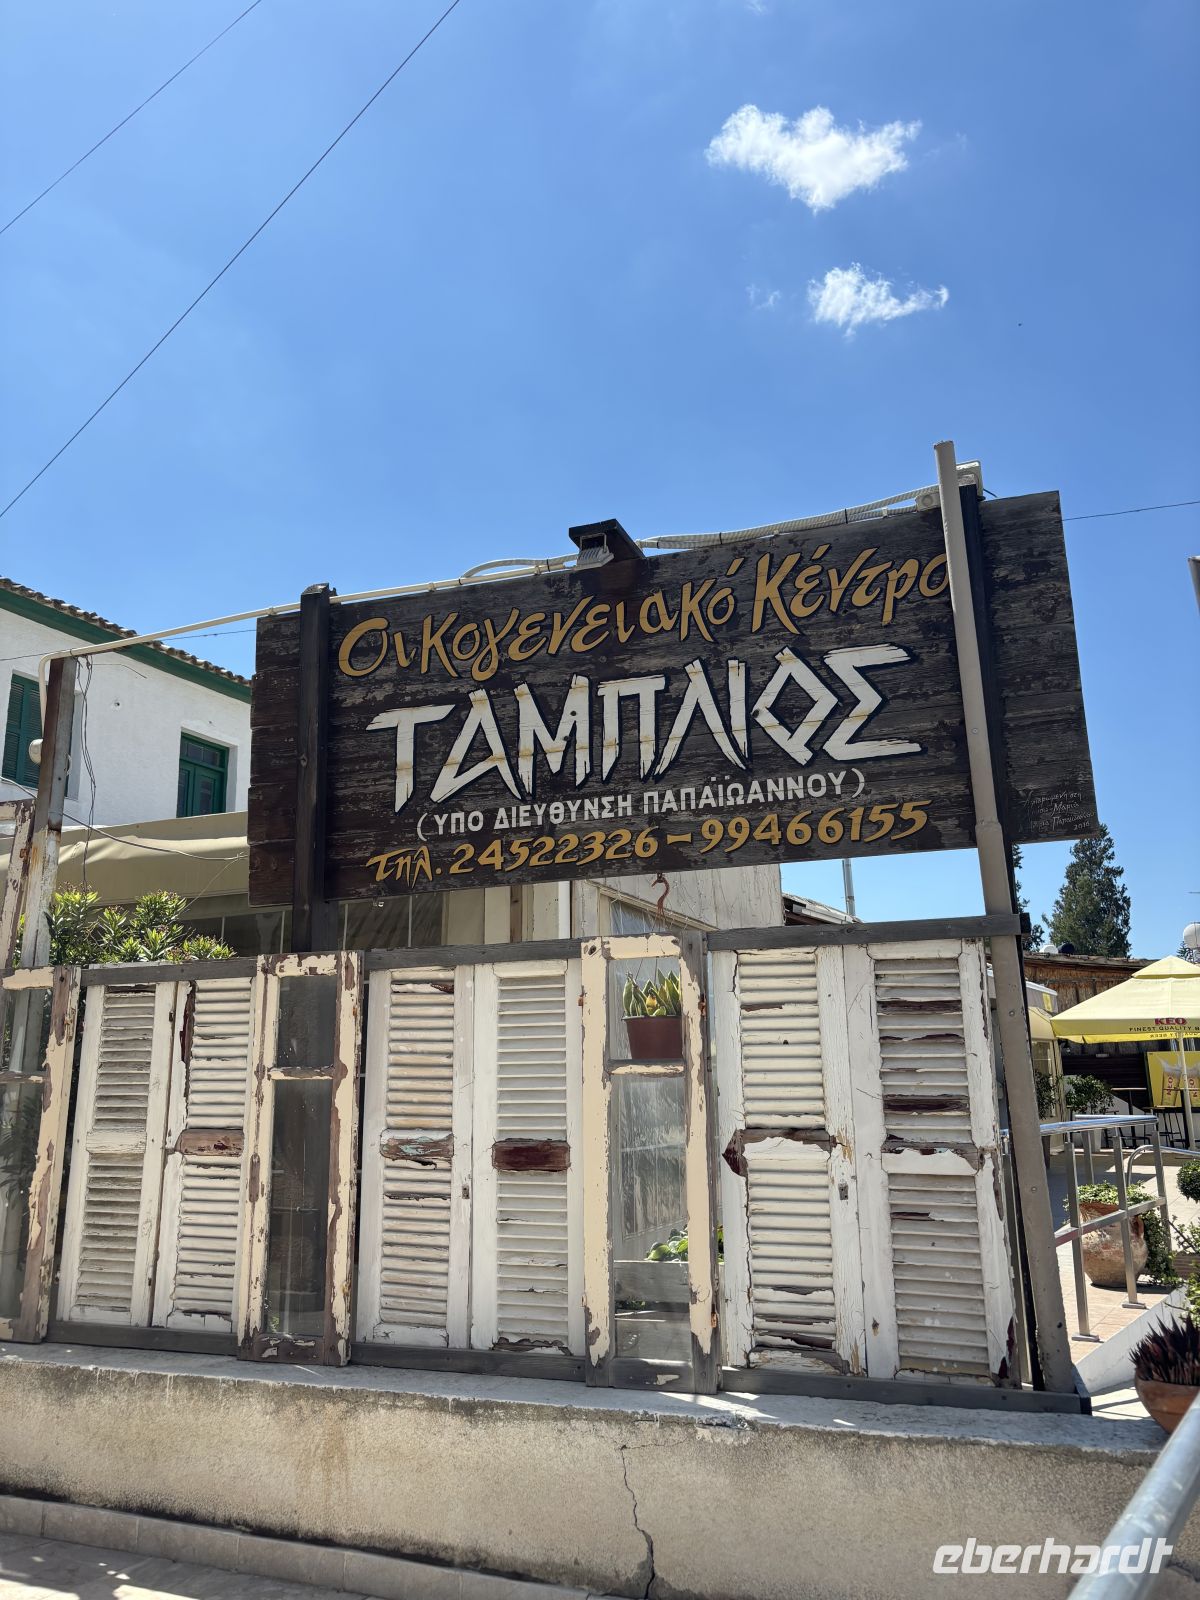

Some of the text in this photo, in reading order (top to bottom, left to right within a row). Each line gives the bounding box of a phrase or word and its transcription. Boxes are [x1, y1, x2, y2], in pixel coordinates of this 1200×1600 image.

[337, 545, 950, 681] Οικογενειακό Κέντρο
[416, 812, 485, 842] (ΥΠΟ
[493, 793, 633, 831] ΔΙΕΥΘΥΝΣΗ
[1154, 1017, 1188, 1026] KEO
